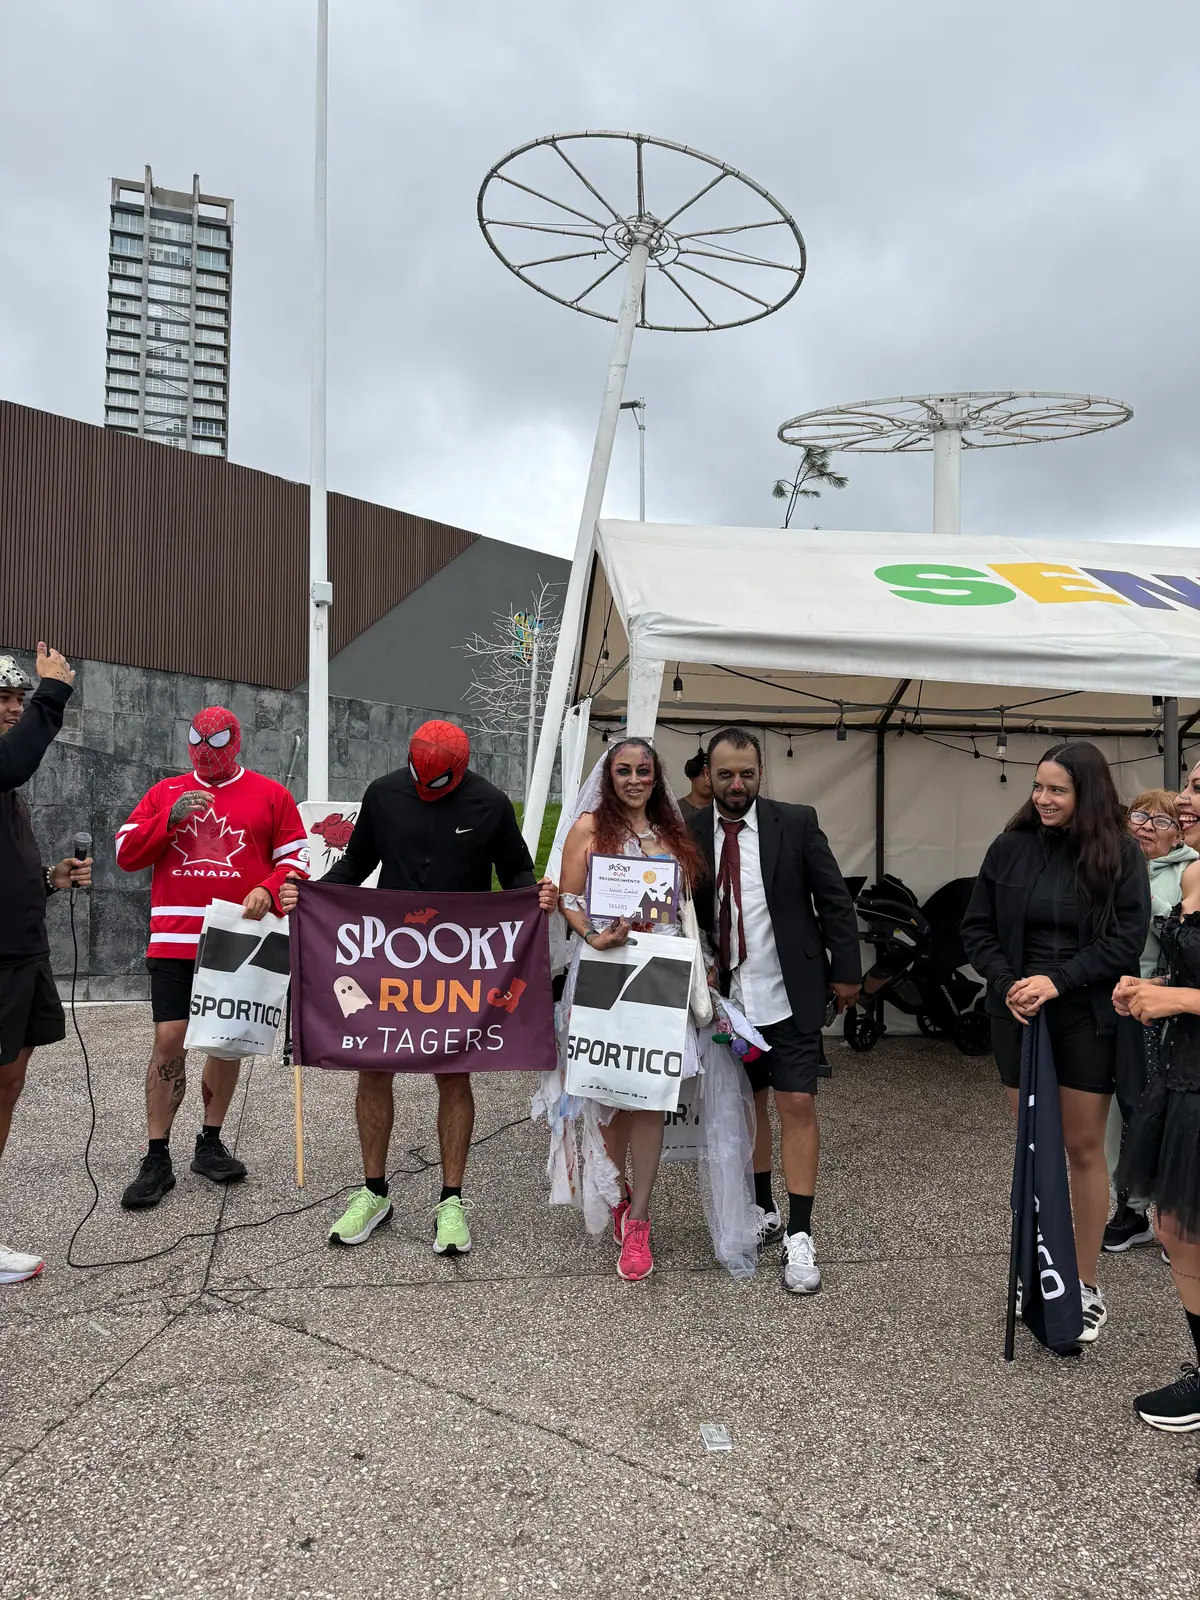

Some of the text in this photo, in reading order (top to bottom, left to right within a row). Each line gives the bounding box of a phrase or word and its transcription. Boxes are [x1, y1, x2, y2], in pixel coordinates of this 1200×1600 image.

[874, 562, 1200, 611] SEN
[172, 869, 242, 878] CANADA
[599, 876, 640, 884] RECONOCIMIENTO
[336, 915, 524, 970] SPOOKY
[190, 994, 282, 1029] SPORTICO
[379, 977, 481, 1013] RUN
[341, 1024, 504, 1054] BY TAGERS
[567, 1035, 682, 1078] SPORTICO
